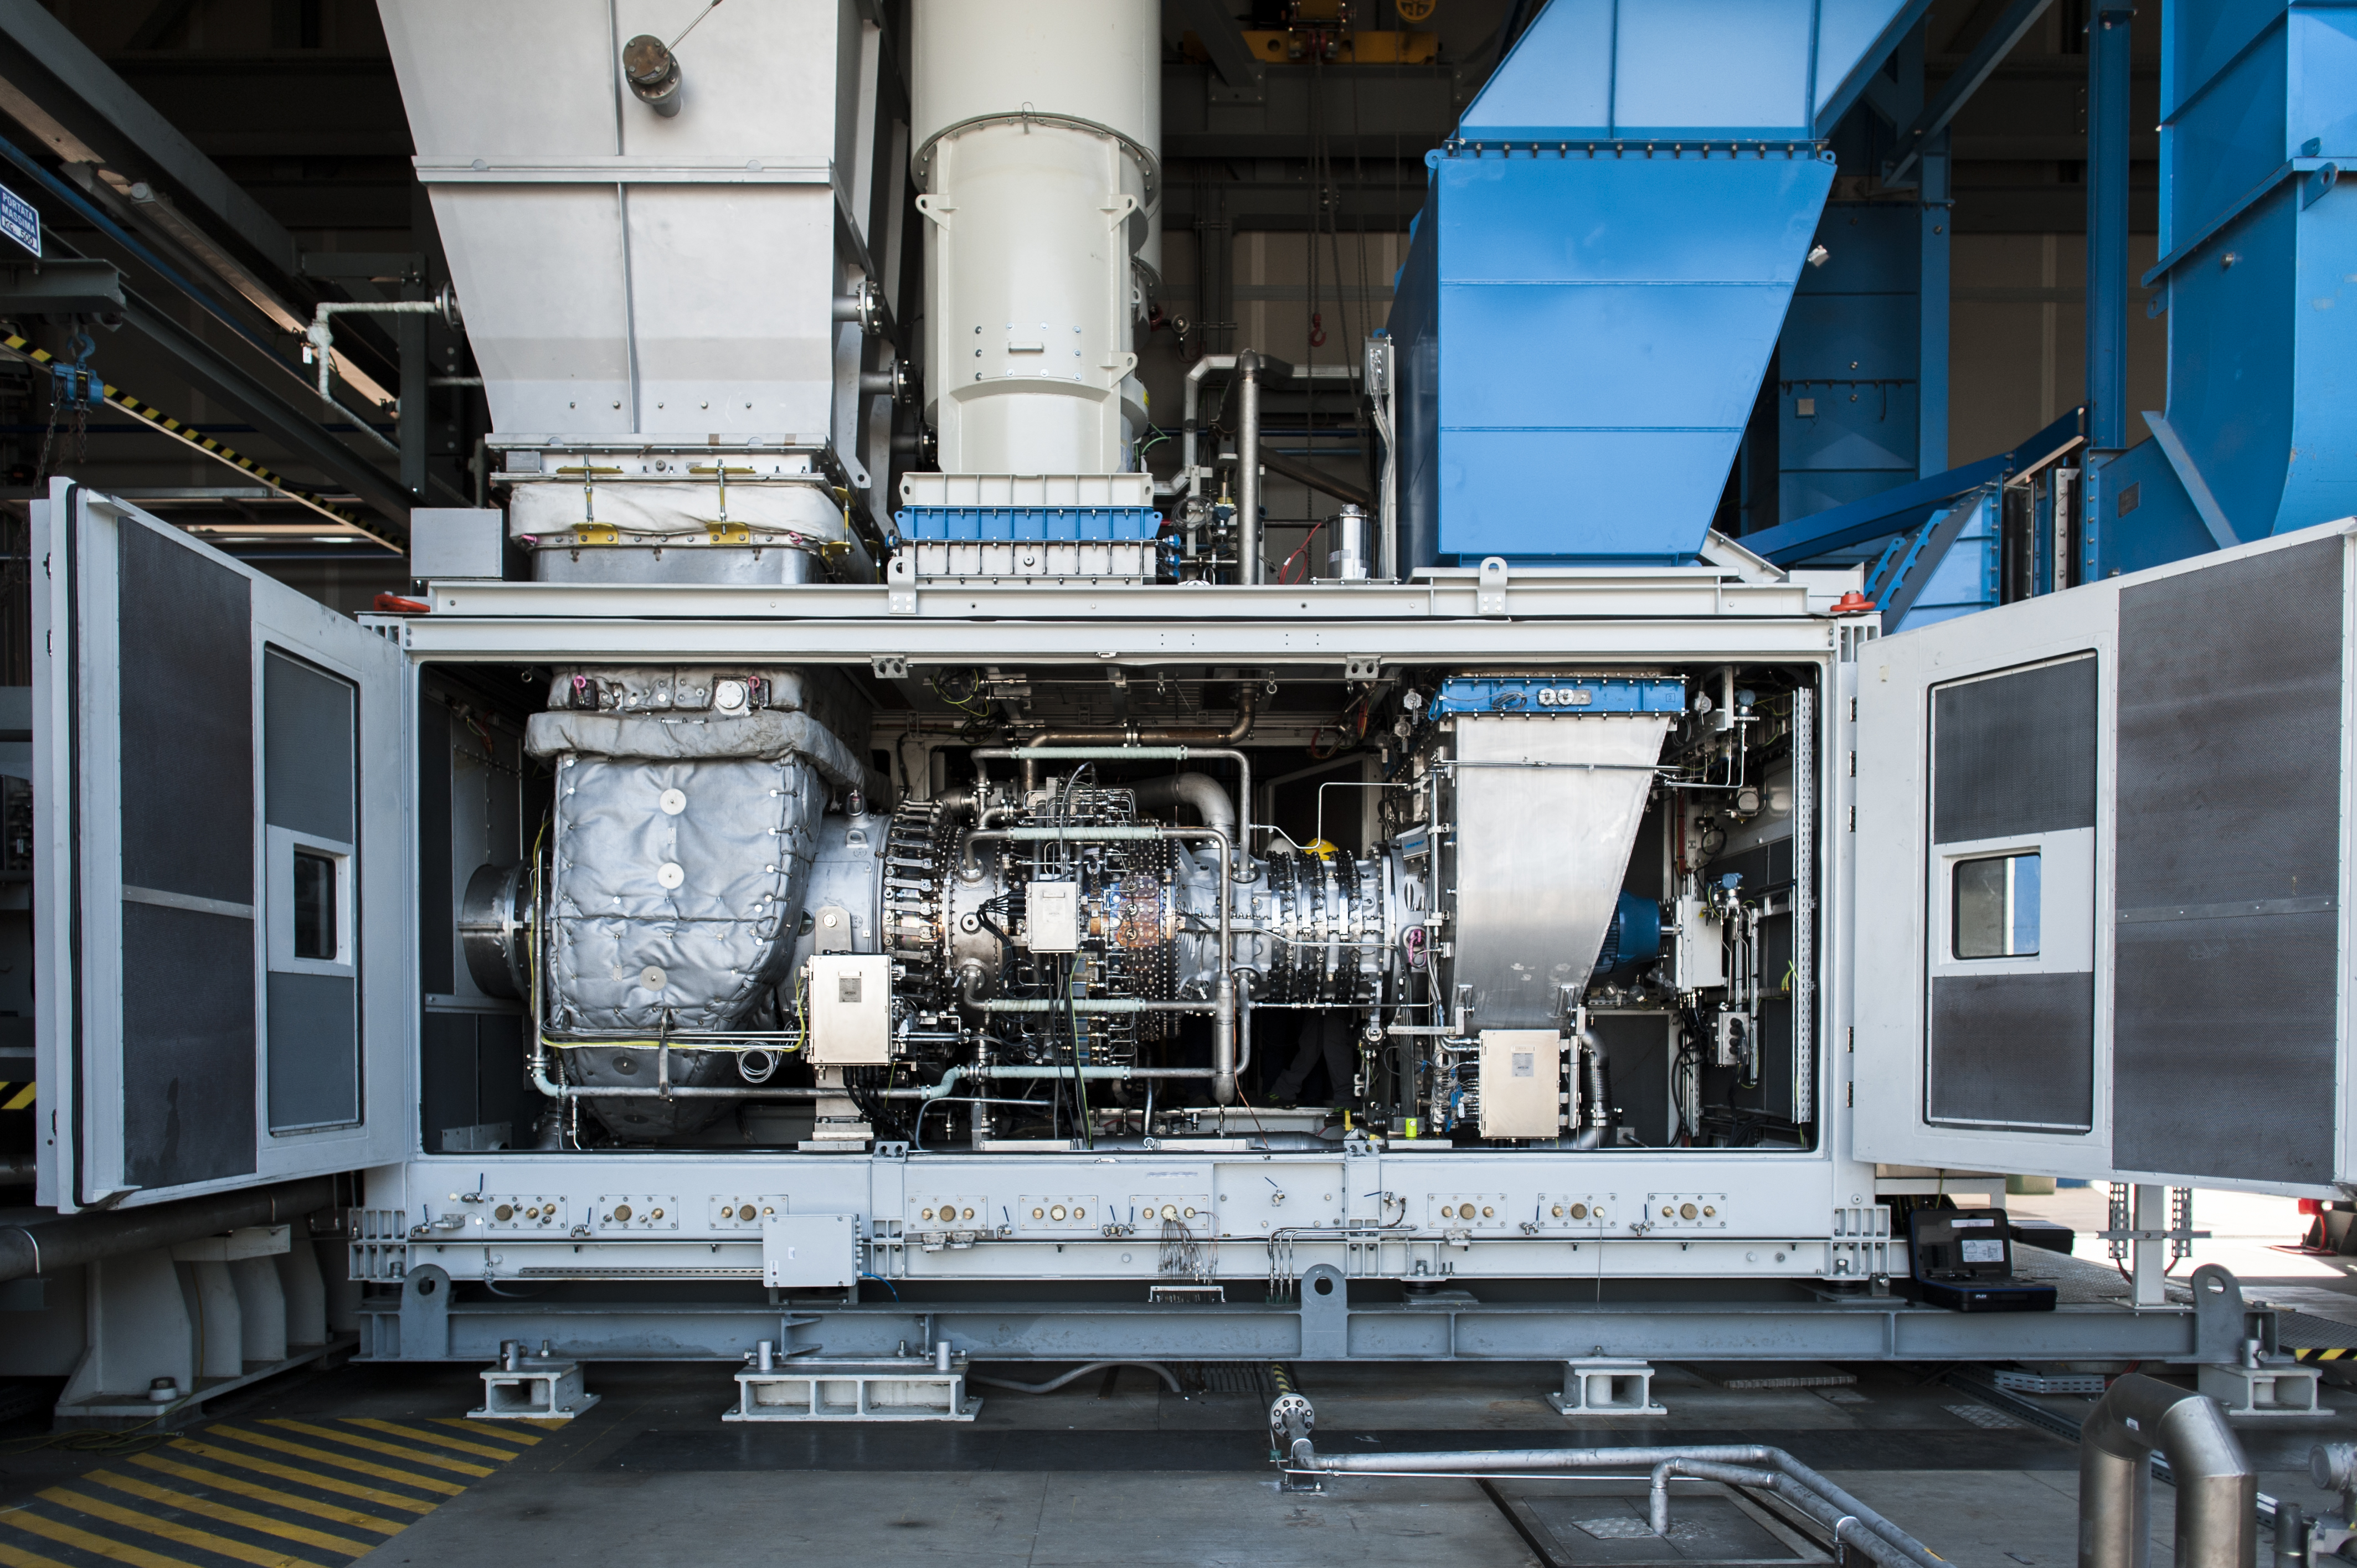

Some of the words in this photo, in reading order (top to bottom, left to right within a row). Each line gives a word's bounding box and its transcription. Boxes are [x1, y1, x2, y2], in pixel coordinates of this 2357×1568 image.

[2, 192, 33, 222] PORTATA
[2, 203, 36, 235] MASSIMA
[20, 229, 34, 246] 500
